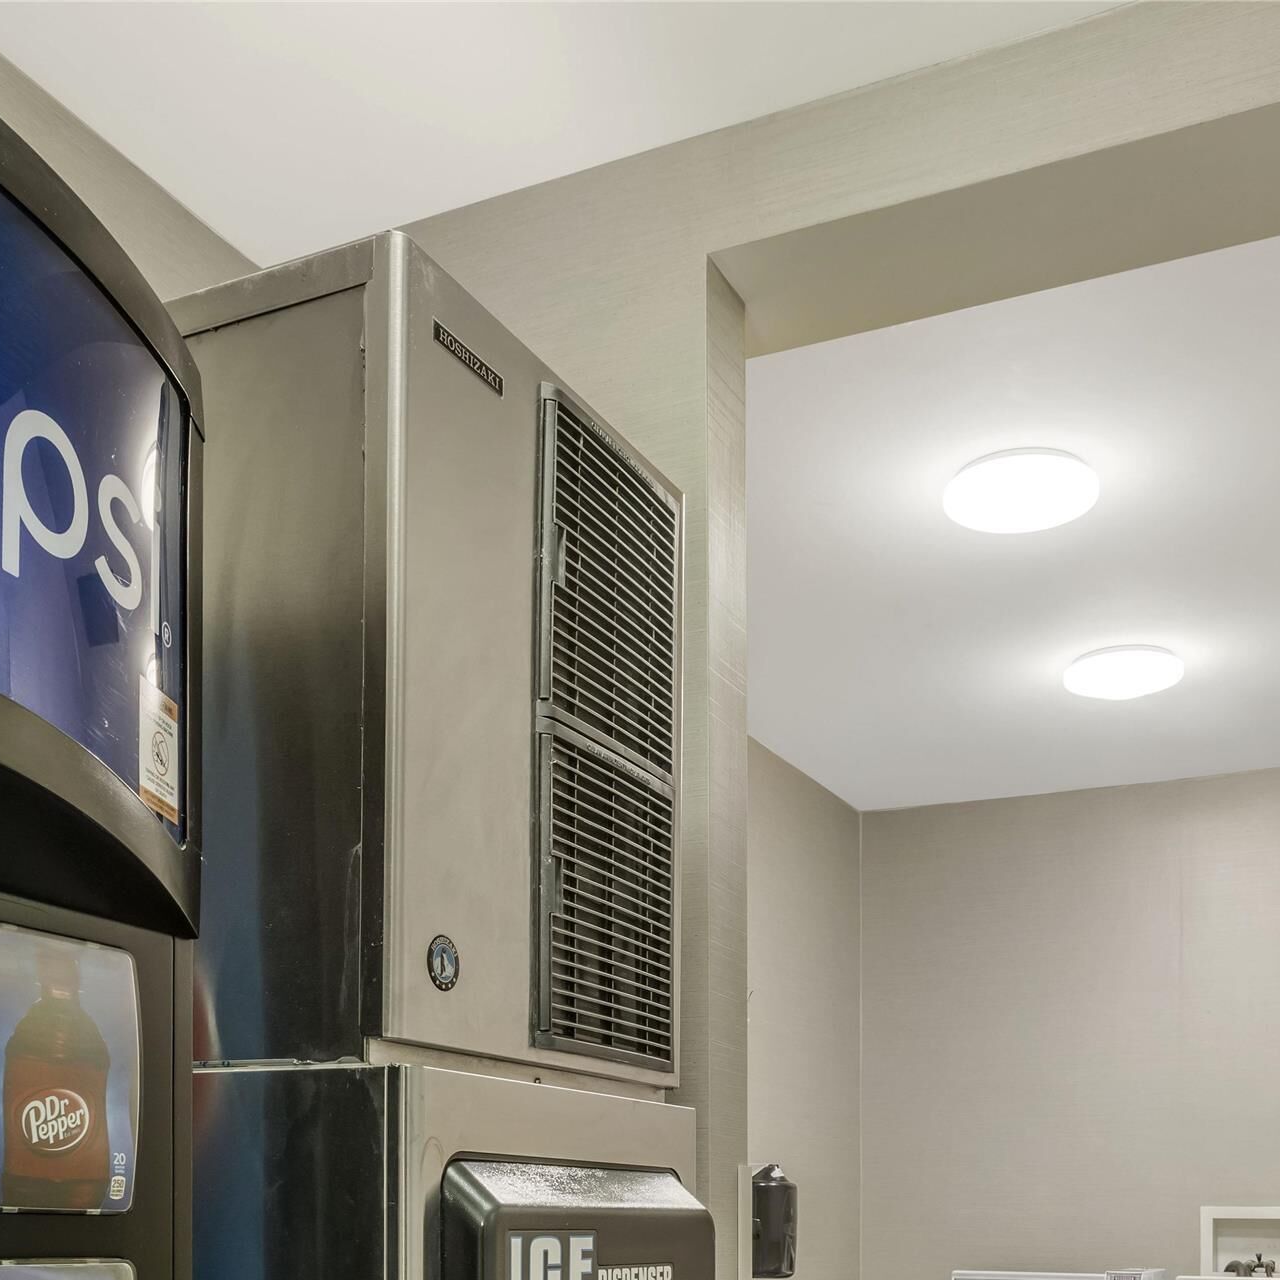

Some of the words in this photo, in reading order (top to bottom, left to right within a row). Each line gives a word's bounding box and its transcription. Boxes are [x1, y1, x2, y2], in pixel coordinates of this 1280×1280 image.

[439, 327, 501, 390] HOSHIZAKI
[22, 1099, 85, 1144] Pepper
[45, 1095, 69, 1121] Dr
[113, 1152, 126, 1165] 20
